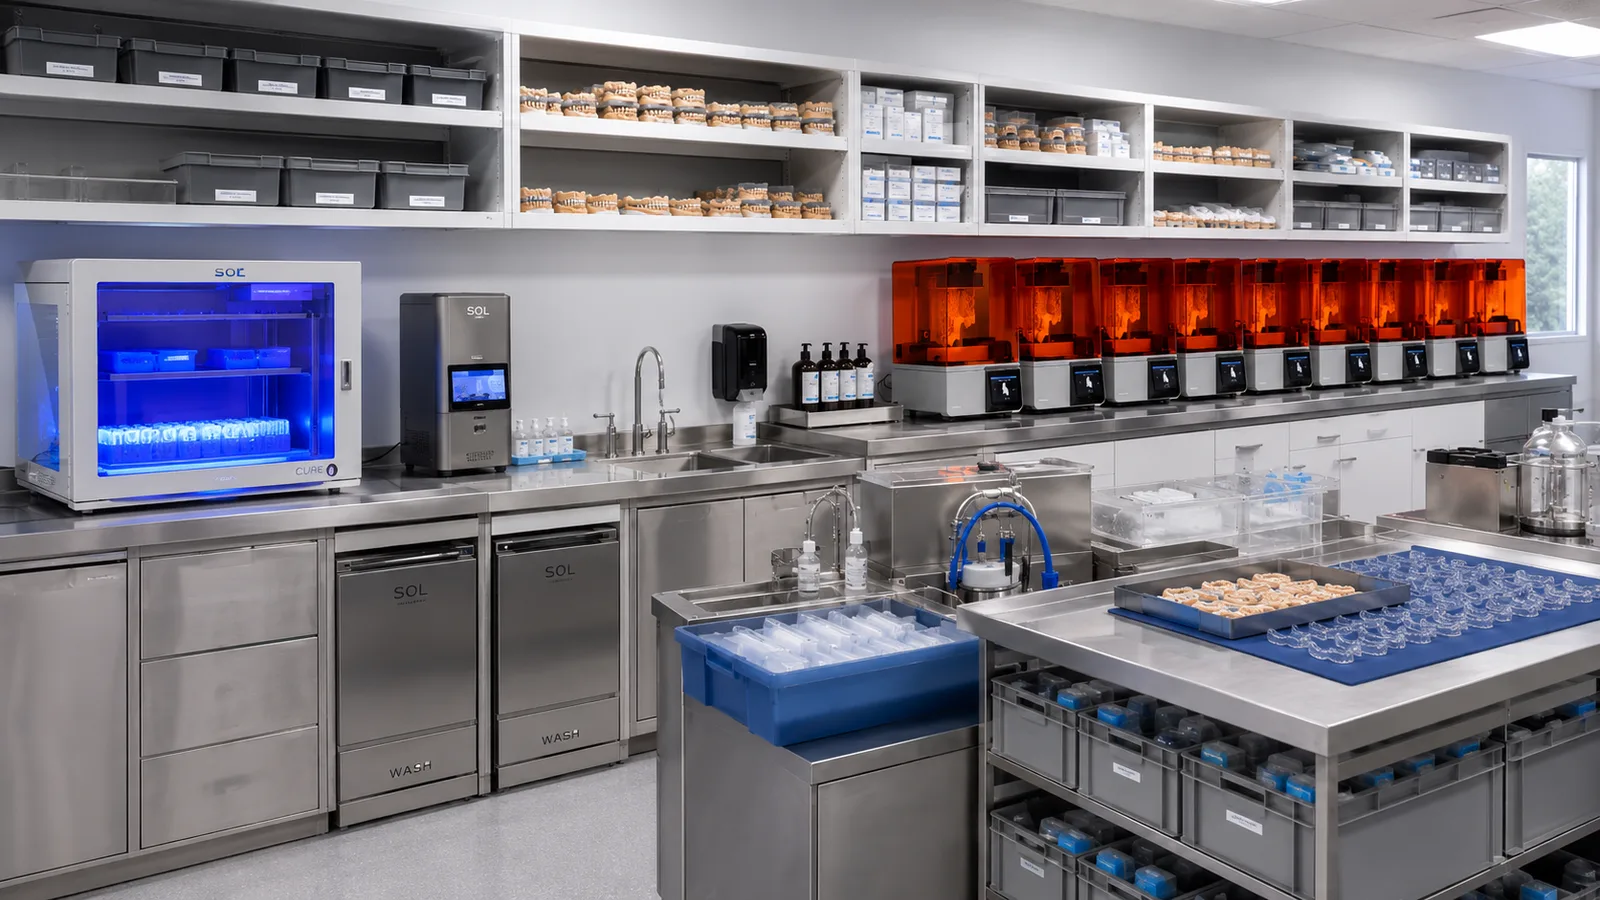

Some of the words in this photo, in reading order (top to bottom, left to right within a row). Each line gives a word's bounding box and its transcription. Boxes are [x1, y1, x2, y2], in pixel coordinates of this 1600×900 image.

[467, 305, 490, 316] SOL
[546, 563, 576, 578] SOL
[393, 583, 429, 600] SOL
[541, 729, 580, 745] WASH
[389, 760, 432, 779] WASH
